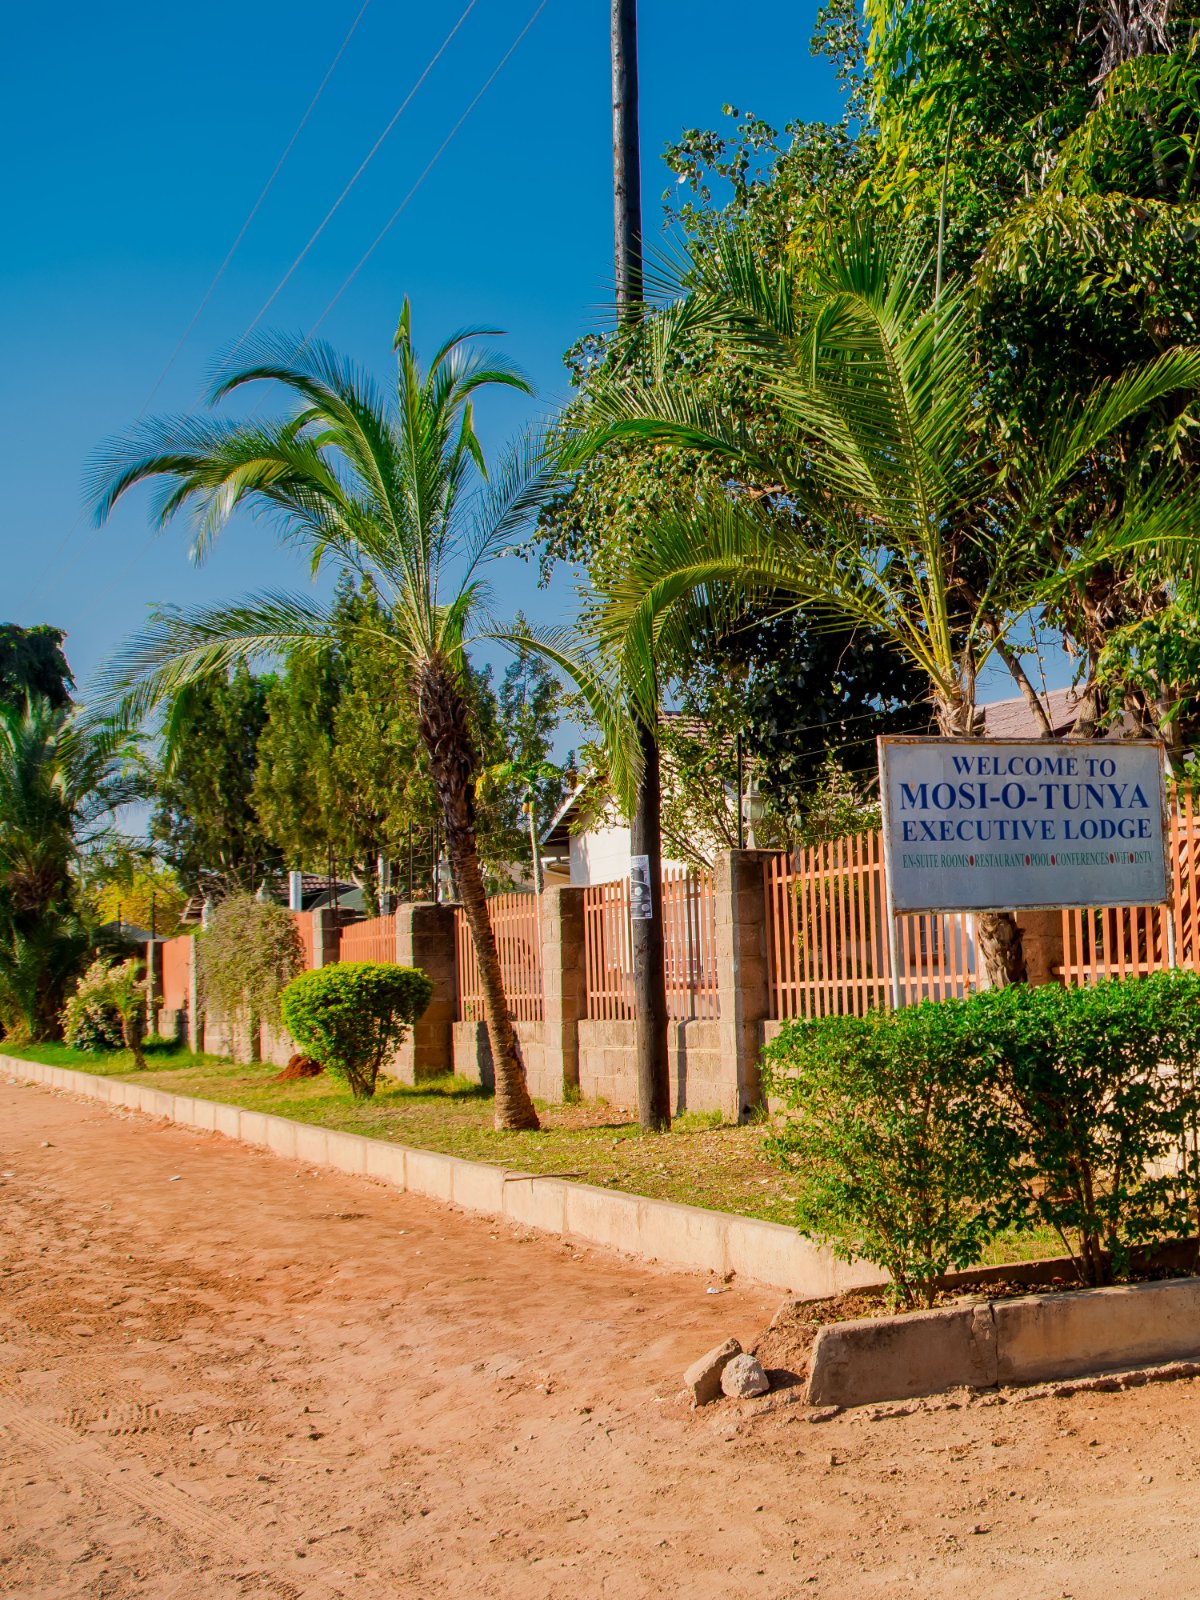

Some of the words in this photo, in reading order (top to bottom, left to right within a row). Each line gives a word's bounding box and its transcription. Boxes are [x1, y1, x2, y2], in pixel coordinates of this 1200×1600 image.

[952, 756, 1078, 776] WELCOME
[1085, 758, 1116, 777] TO
[899, 782, 1149, 809] MOSI-O-TUNYA
[902, 819, 1056, 841] EXECUTIVE
[1064, 818, 1152, 840] LODGE
[902, 854, 939, 868] EN-SUITE
[940, 854, 969, 867] ROOMS
[975, 854, 1025, 867] RESTAURANT
[1030, 853, 1051, 866] POOL
[1056, 853, 1109, 866] CONFERENCES
